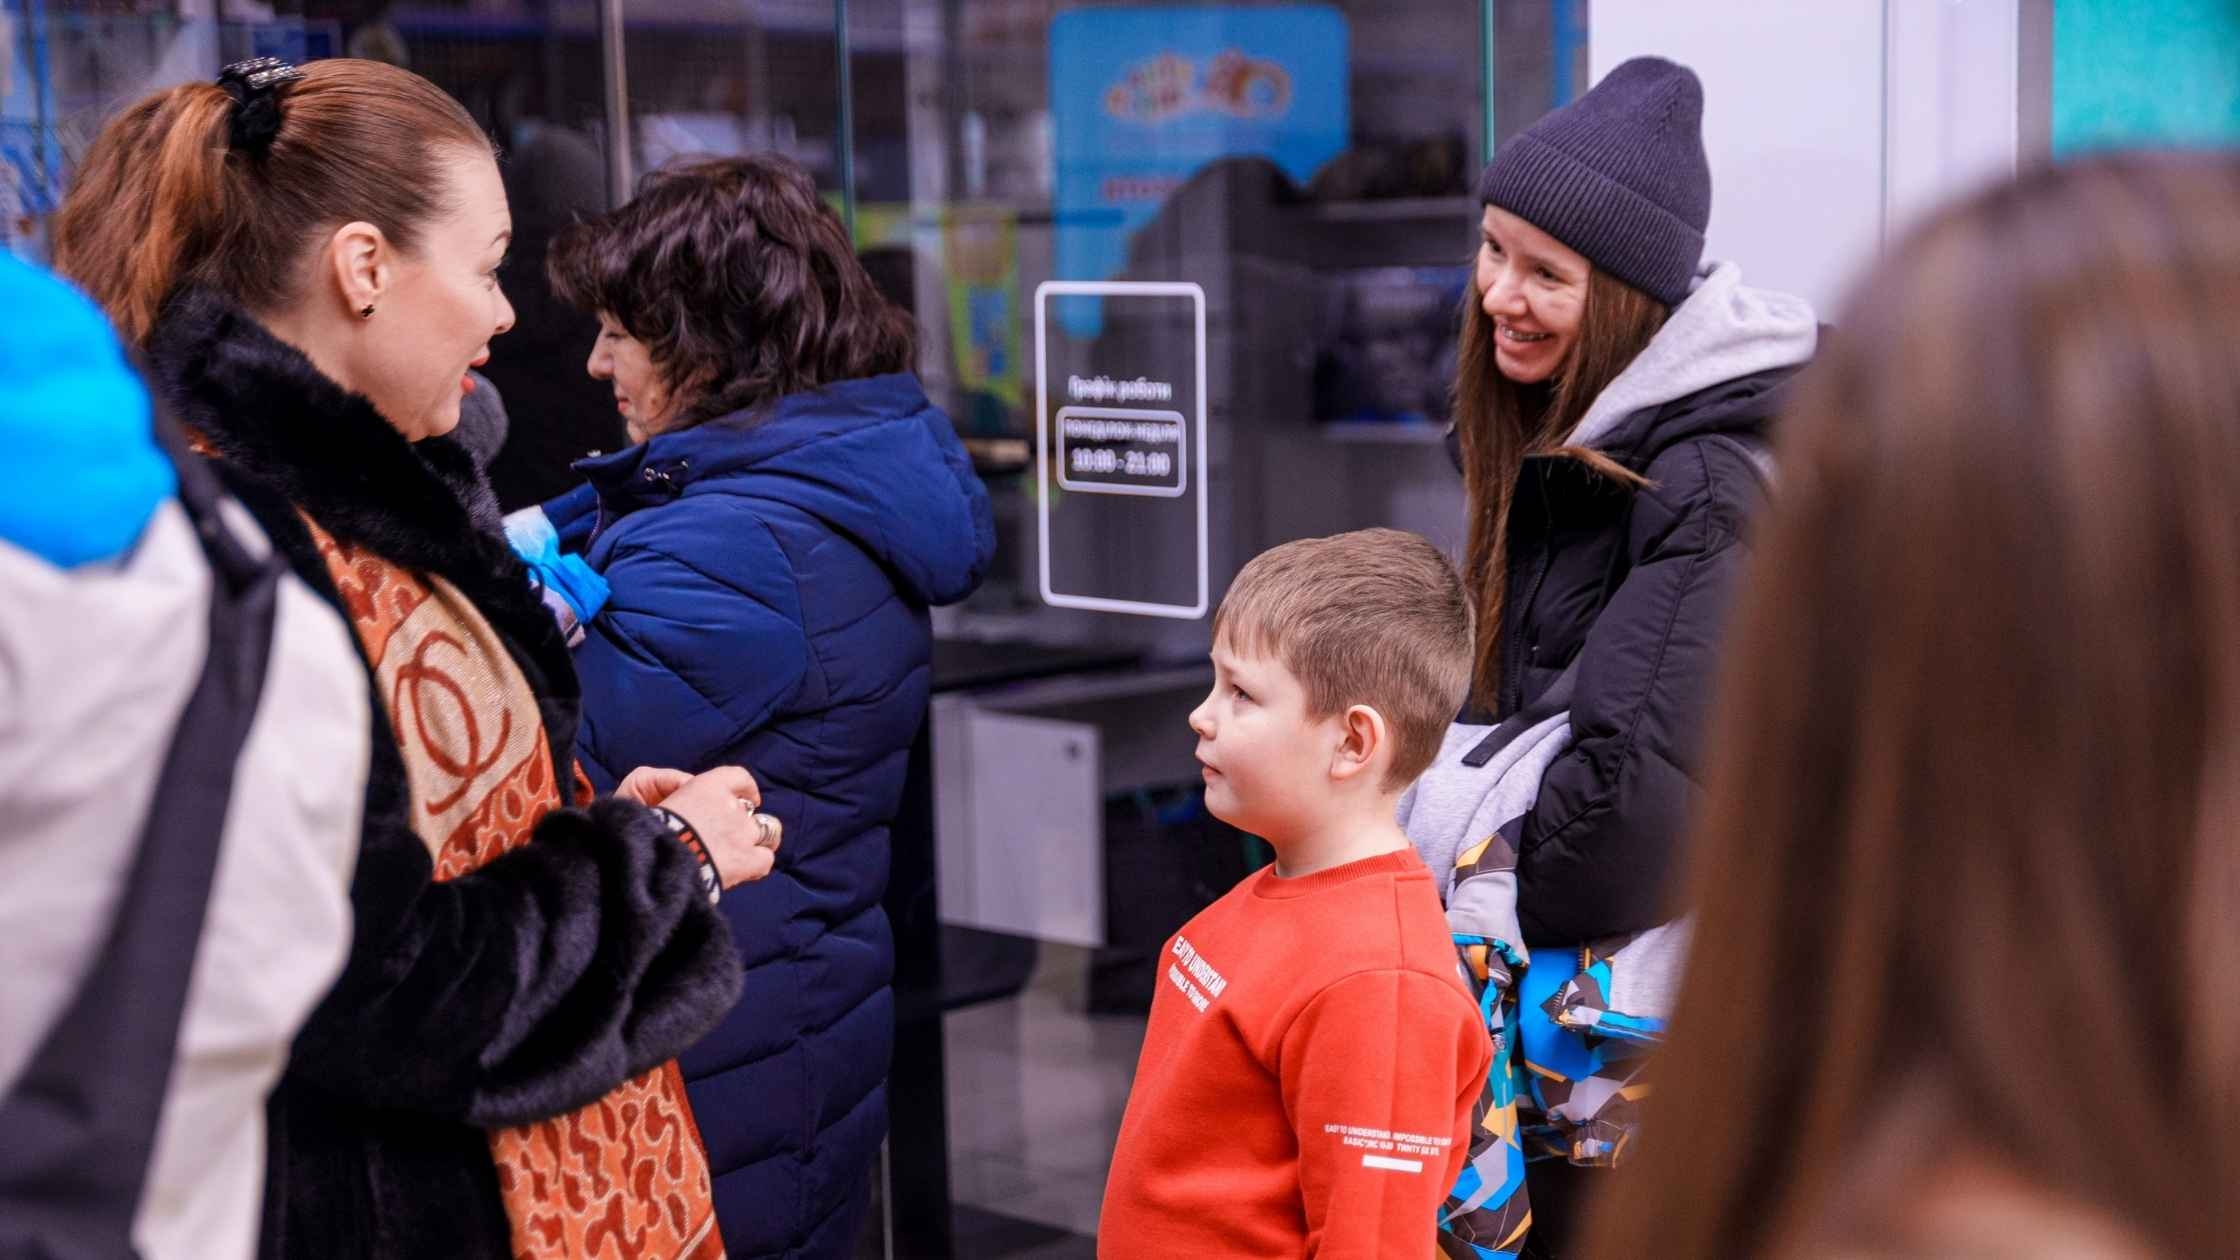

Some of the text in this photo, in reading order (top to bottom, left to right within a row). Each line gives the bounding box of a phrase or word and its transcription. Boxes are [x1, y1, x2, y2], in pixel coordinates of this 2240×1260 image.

[1068, 375, 1172, 403] Графік роботи
[1071, 447, 1117, 474] 10:00
[1124, 450, 1171, 477] 21:00
